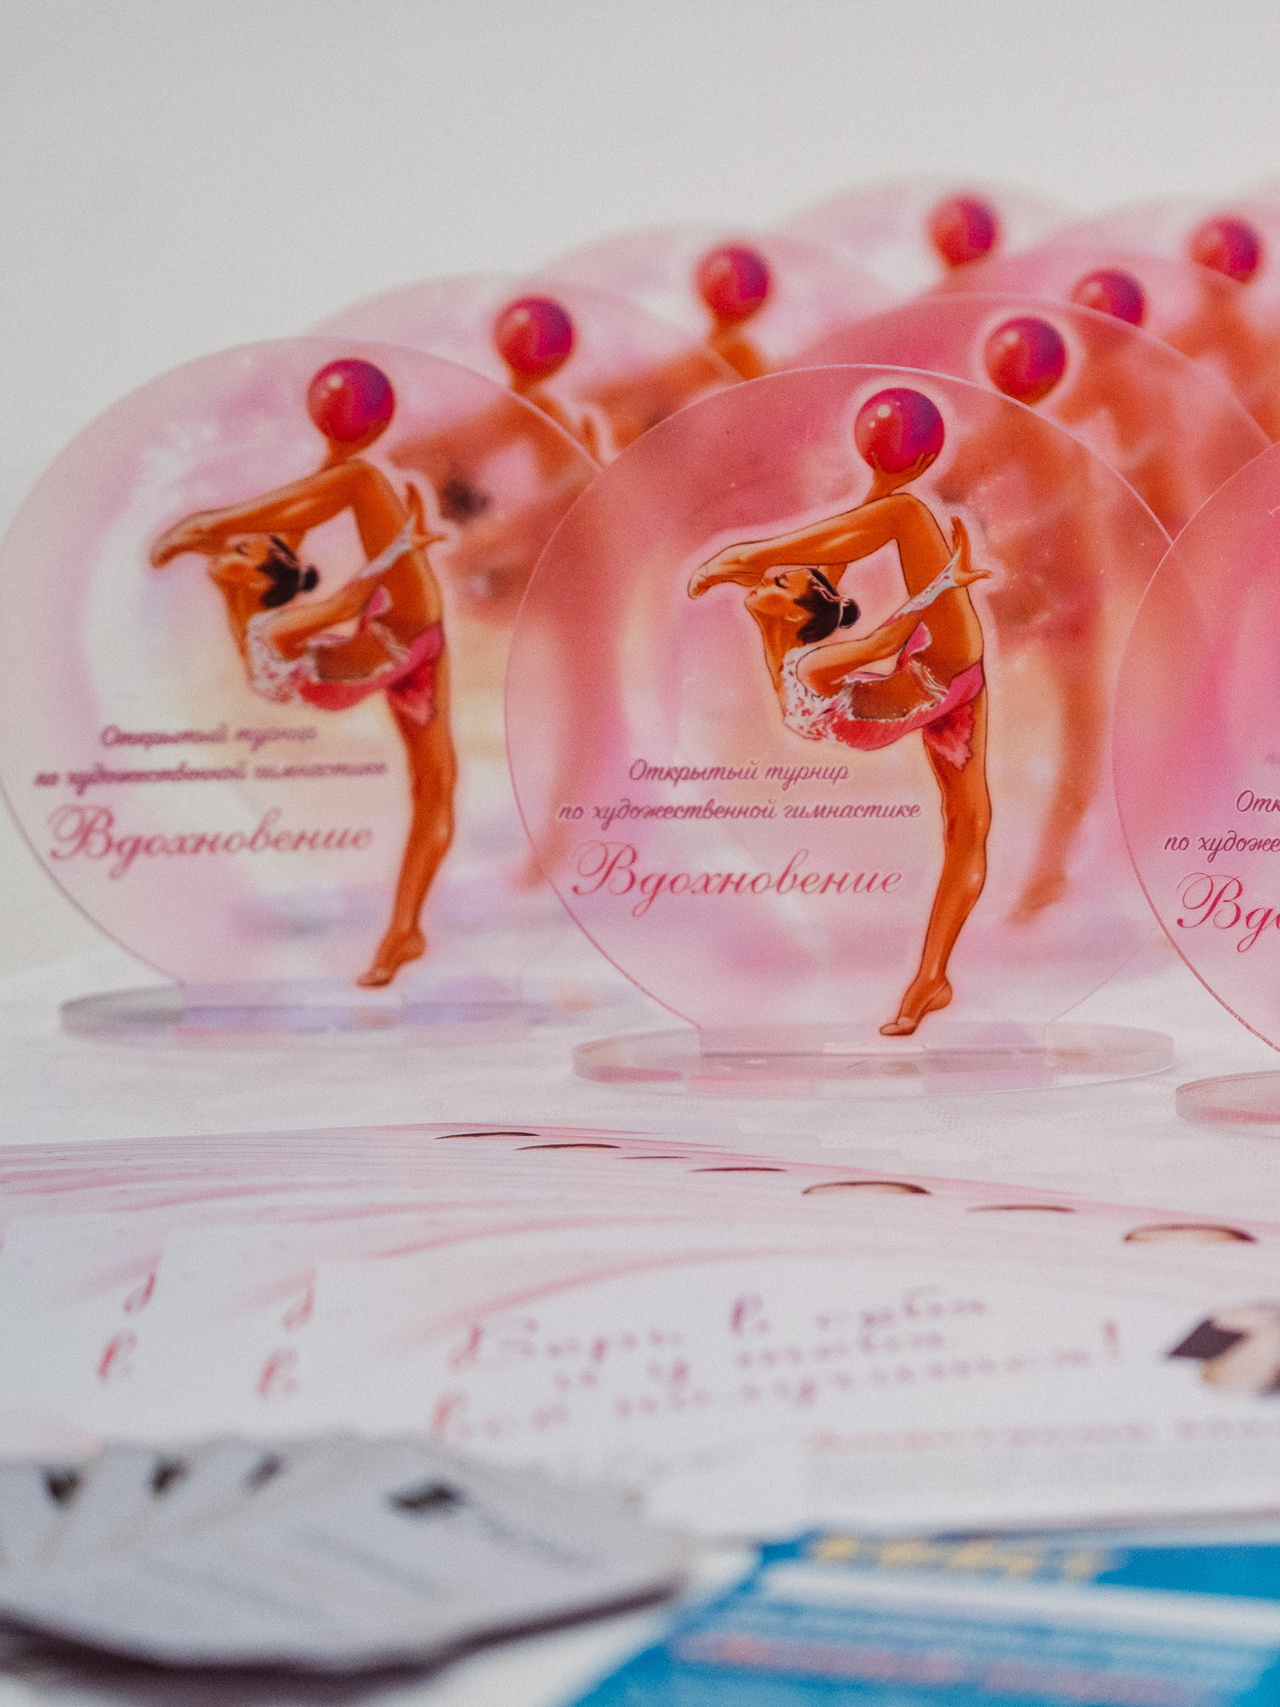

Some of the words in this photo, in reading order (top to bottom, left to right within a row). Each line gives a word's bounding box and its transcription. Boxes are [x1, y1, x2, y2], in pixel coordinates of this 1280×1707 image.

[628, 757, 759, 784] Открытый
[764, 766, 850, 791] турнир
[557, 804, 584, 820] по
[591, 798, 778, 830] художественной
[784, 802, 921, 820] гимнастике
[46, 803, 374, 879] Вдохновение
[1163, 834, 1191, 852] по
[571, 840, 902, 918] Вдохновение
